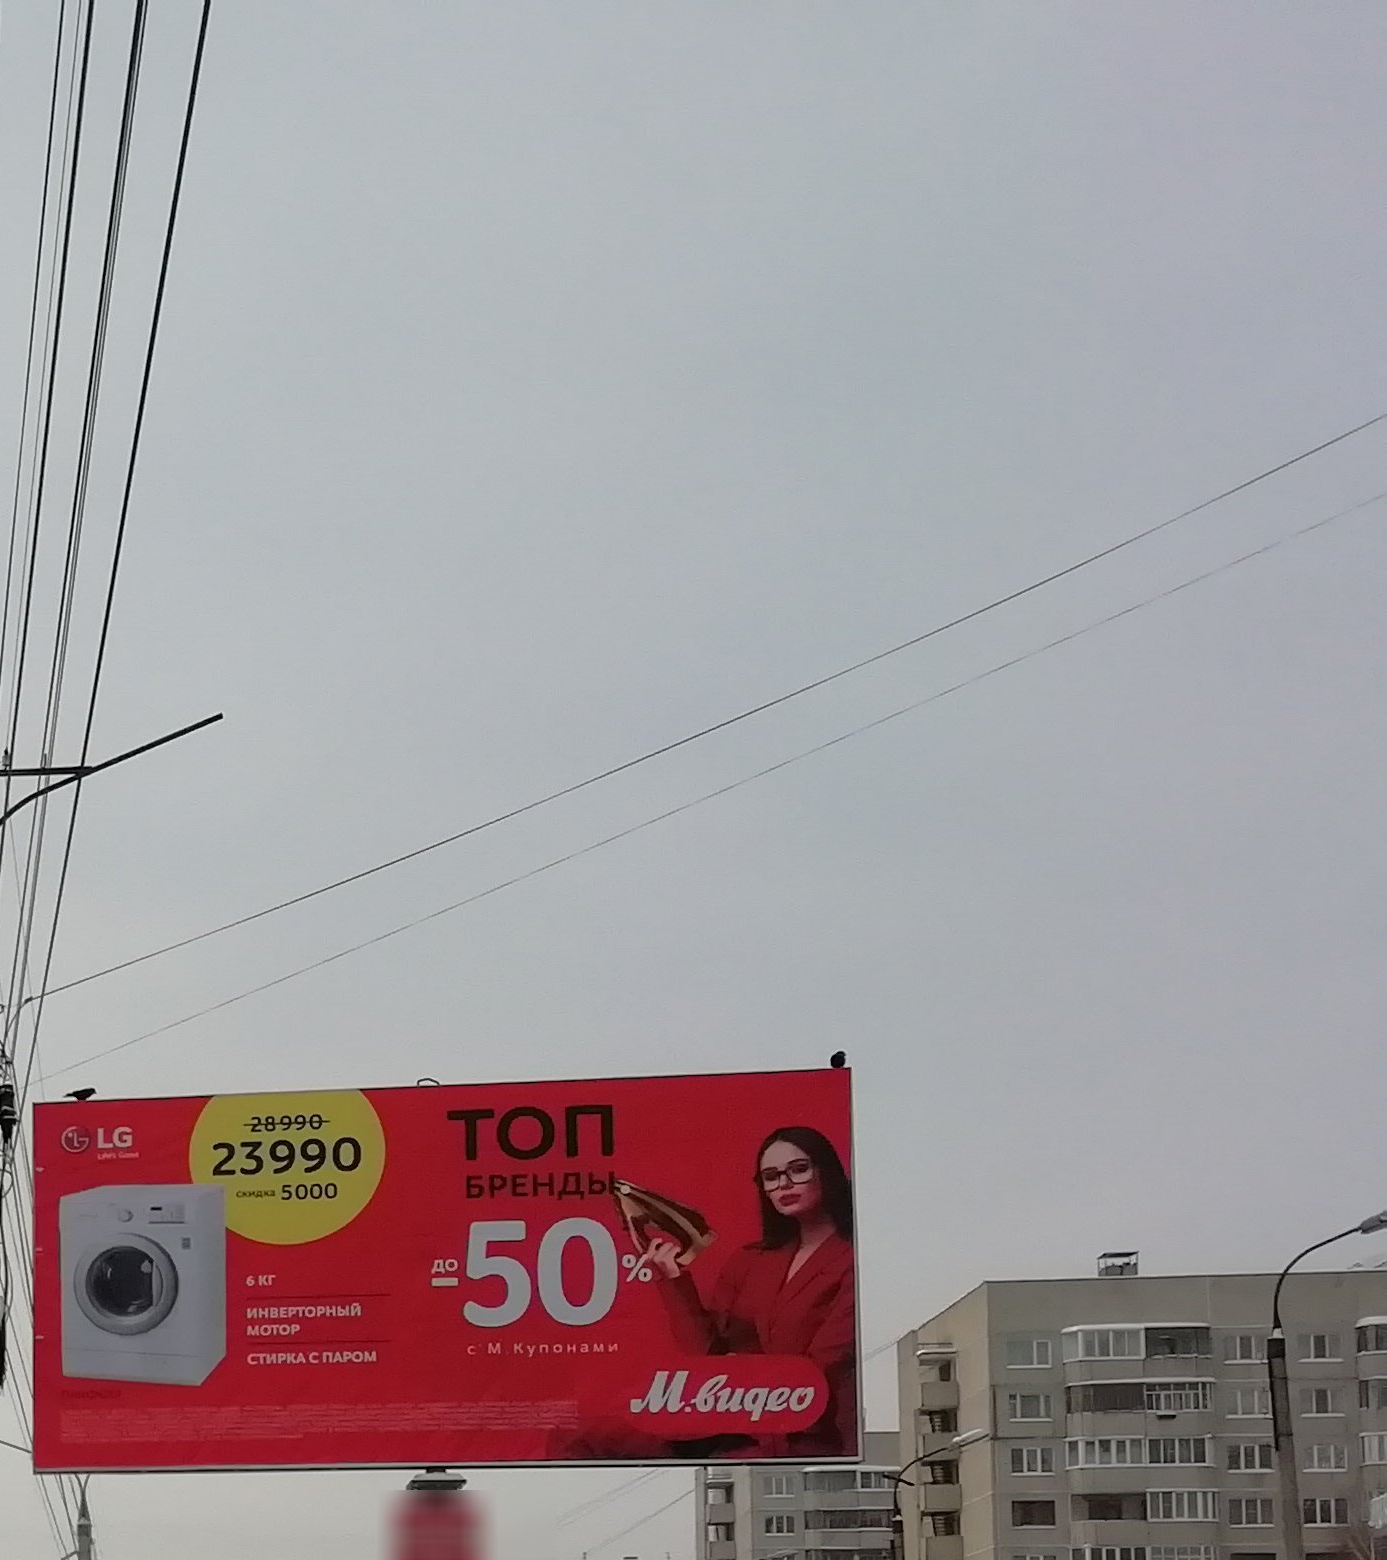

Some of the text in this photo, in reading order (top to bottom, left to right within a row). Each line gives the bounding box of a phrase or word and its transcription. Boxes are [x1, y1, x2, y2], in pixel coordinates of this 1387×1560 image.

[247, 1114, 328, 1133] 28990
[446, 1104, 615, 1161] ТОП
[97, 1126, 134, 1149] LG
[212, 1136, 362, 1176] 23990
[236, 1183, 338, 1200] скидка 5000
[466, 1171, 616, 1200] БРЕНДЫ
[246, 1274, 276, 1287] 6 КГ
[246, 1302, 362, 1319] ИНВЕРТОРНЫЙ
[246, 1323, 300, 1336] МОТОР
[247, 1350, 377, 1366] СТИРКА С ПАРОМ
[629, 1370, 815, 1422] М.видео
